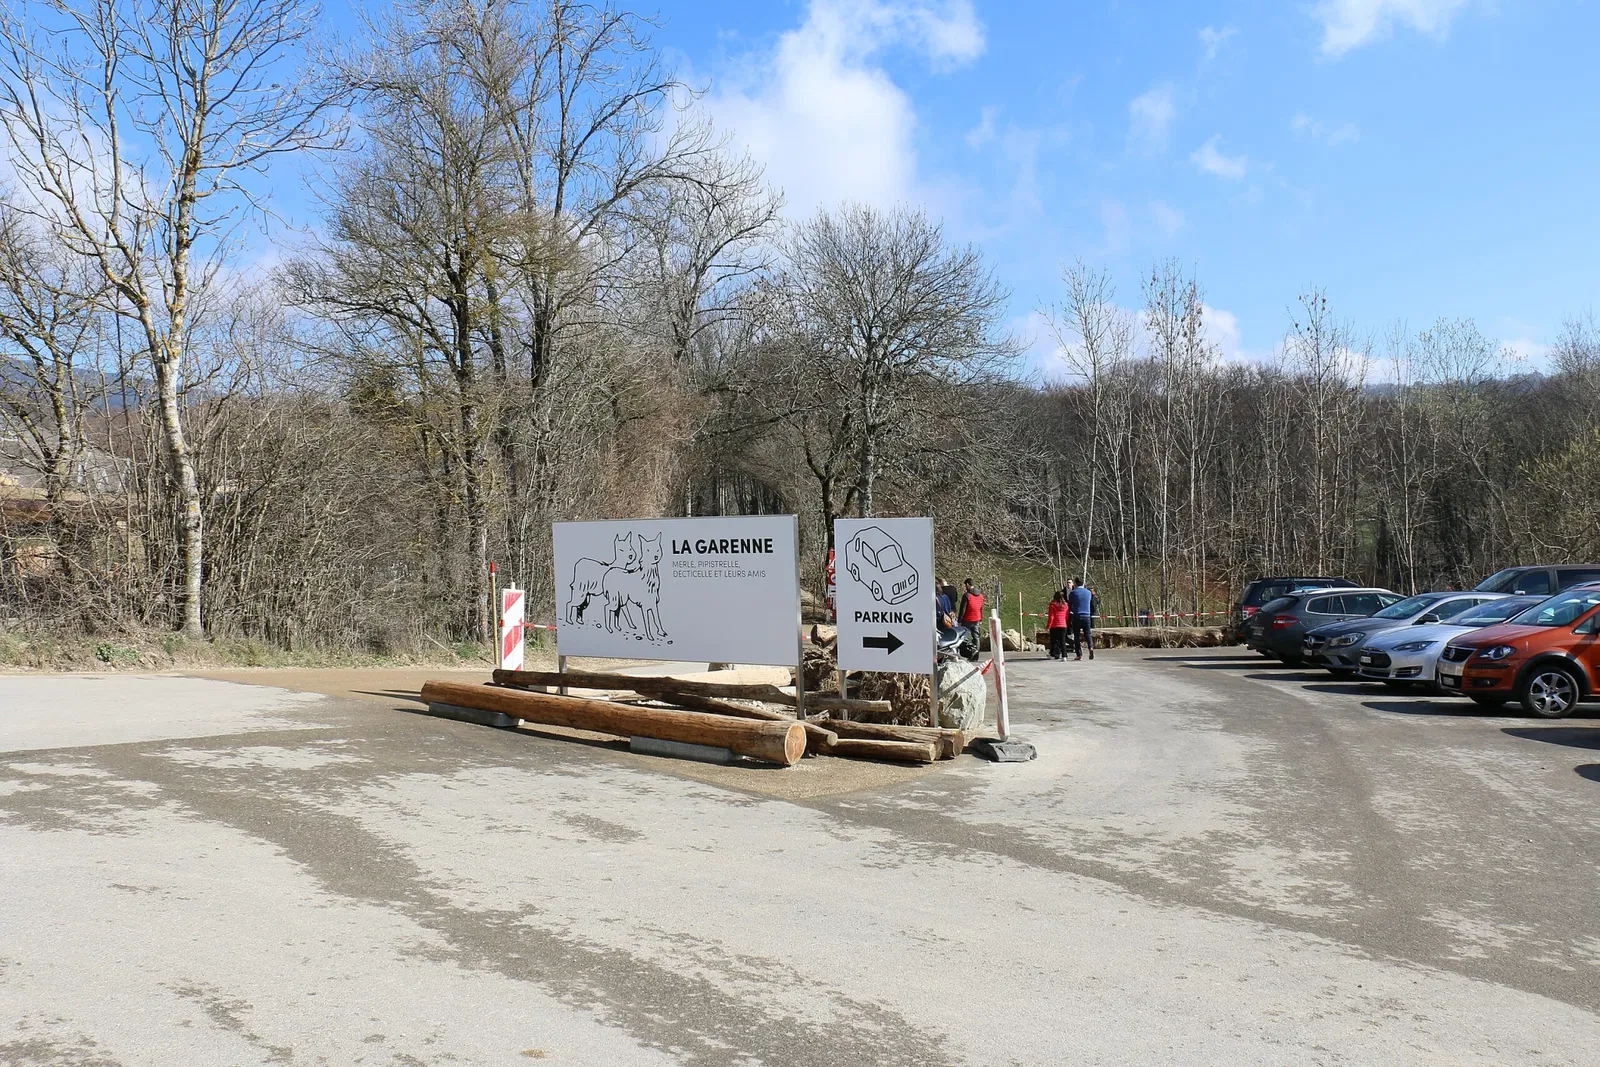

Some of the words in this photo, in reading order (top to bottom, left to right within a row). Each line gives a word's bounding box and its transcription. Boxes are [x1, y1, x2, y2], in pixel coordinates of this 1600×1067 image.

[672, 539, 692, 555] LA
[695, 538, 774, 555] GARENNE
[672, 560, 697, 569] MERLE,
[698, 560, 741, 569] PIPISTRELLE,
[673, 570, 713, 578] DECTICELLE
[714, 570, 723, 578] ET
[724, 570, 747, 578] LEURS
[747, 570, 767, 578] AMIS
[854, 610, 914, 624] PARKING
